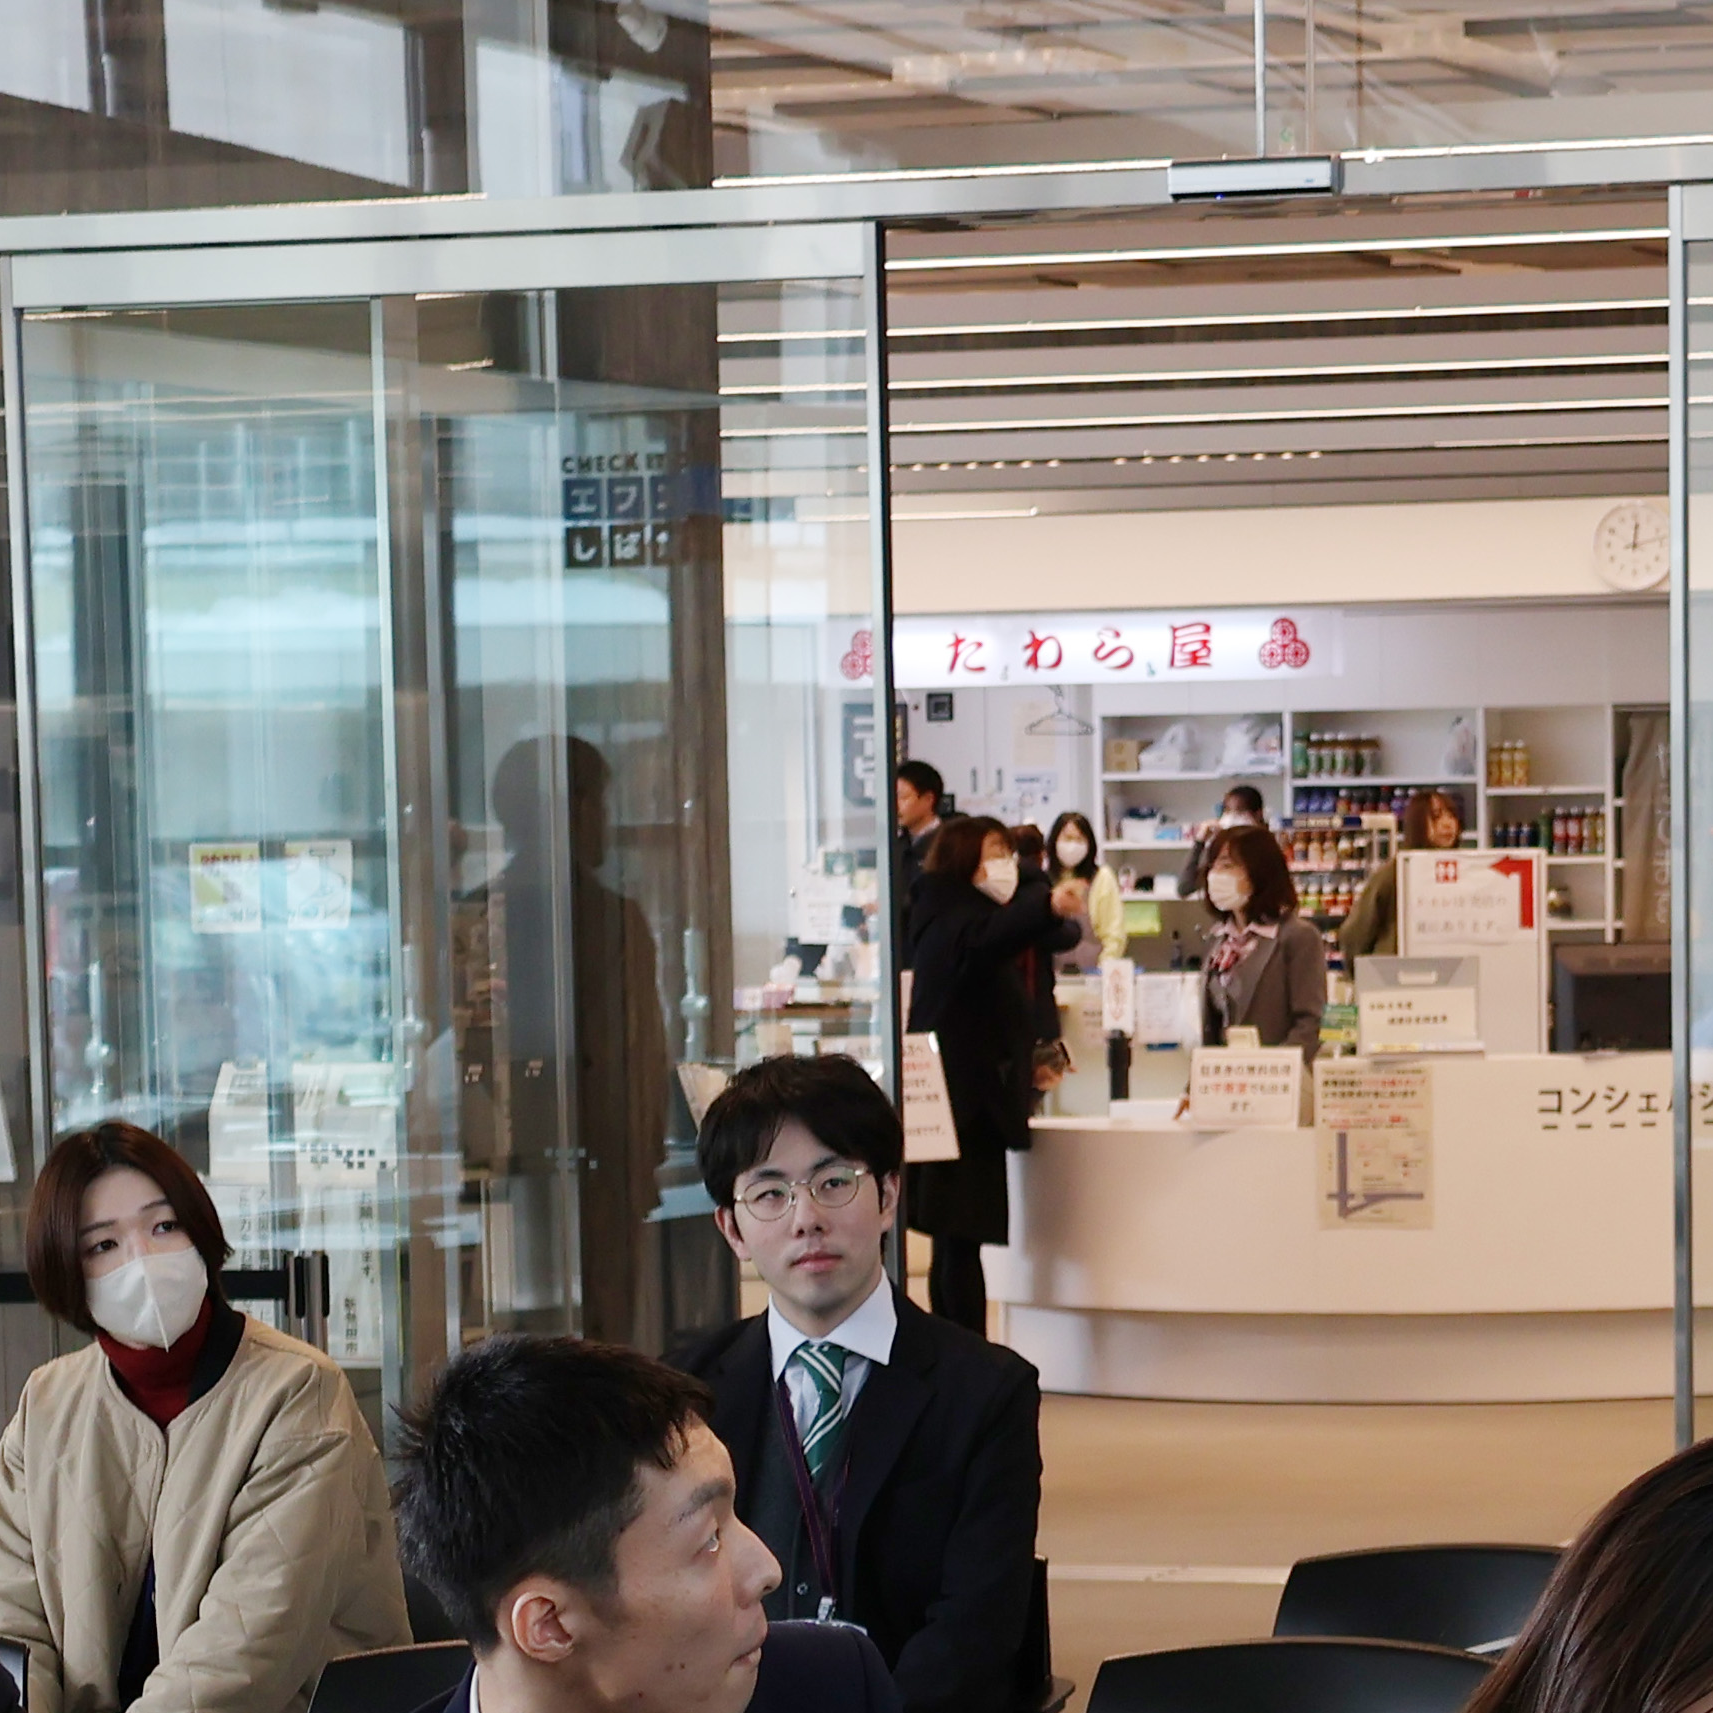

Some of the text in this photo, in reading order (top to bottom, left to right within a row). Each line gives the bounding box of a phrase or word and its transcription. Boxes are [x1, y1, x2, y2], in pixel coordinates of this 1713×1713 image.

[562, 452, 638, 473] CHECK
[947, 621, 1213, 675] たわら屋
